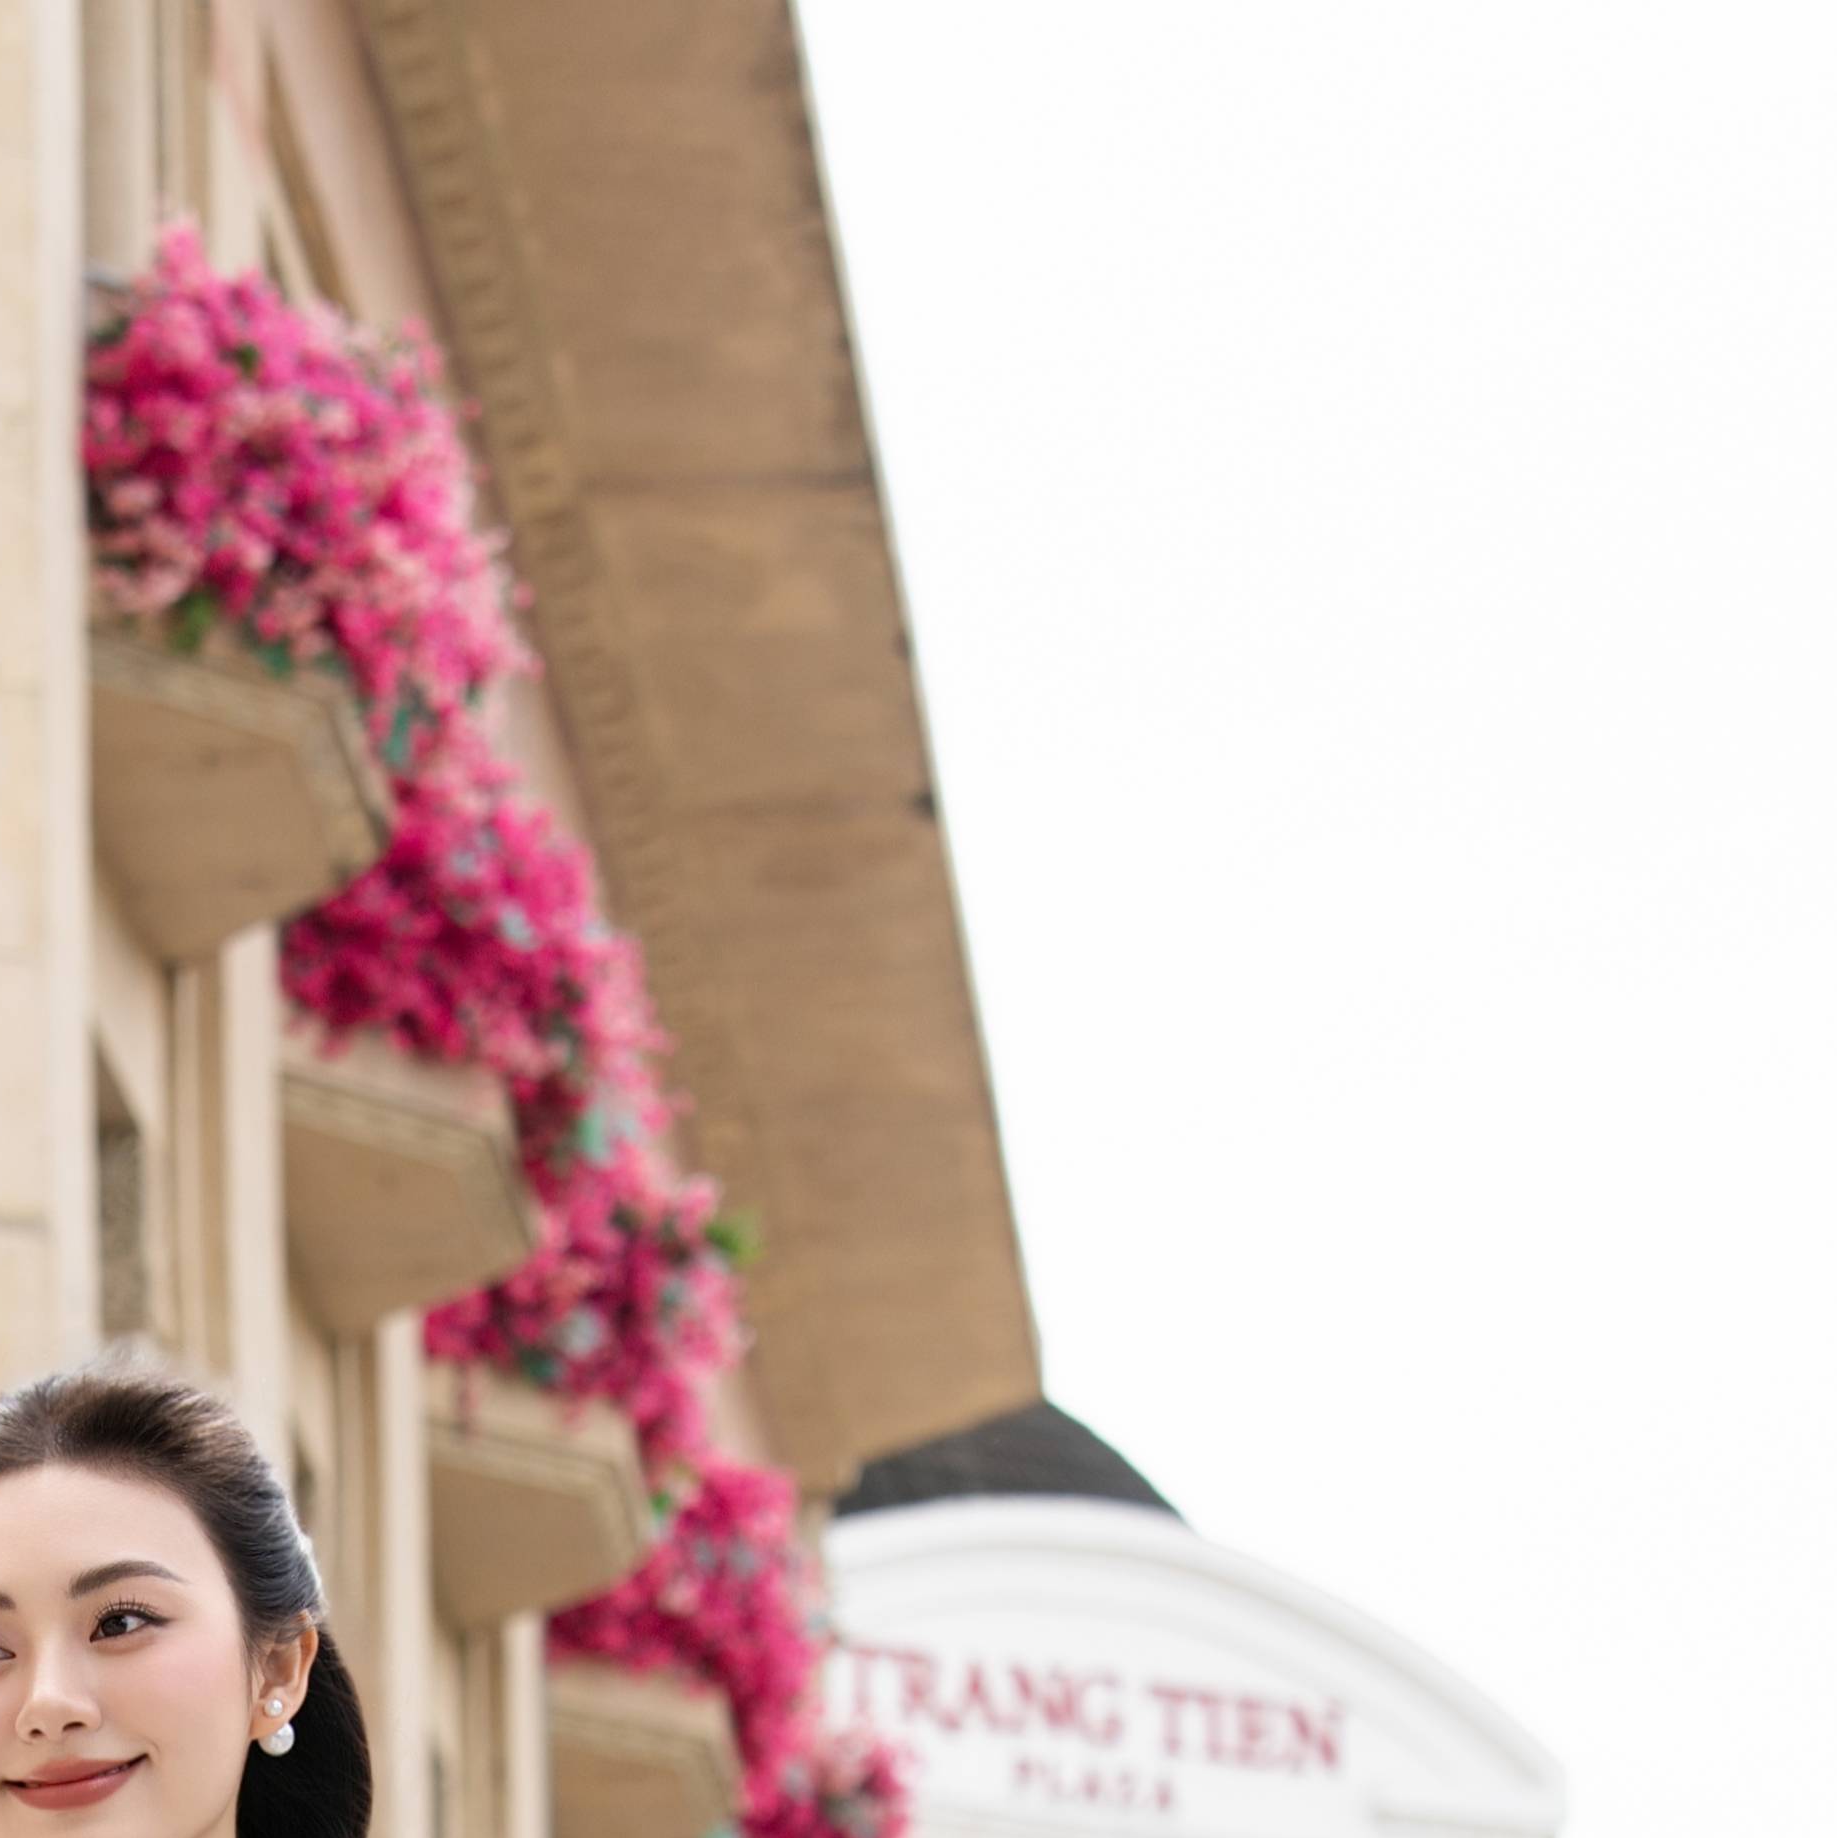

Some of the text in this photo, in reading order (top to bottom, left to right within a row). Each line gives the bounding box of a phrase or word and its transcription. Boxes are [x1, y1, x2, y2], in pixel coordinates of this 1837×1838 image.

[842, 1646, 1347, 1775] TRANG TIEN
[1012, 1755, 1176, 1811] PLAZA
